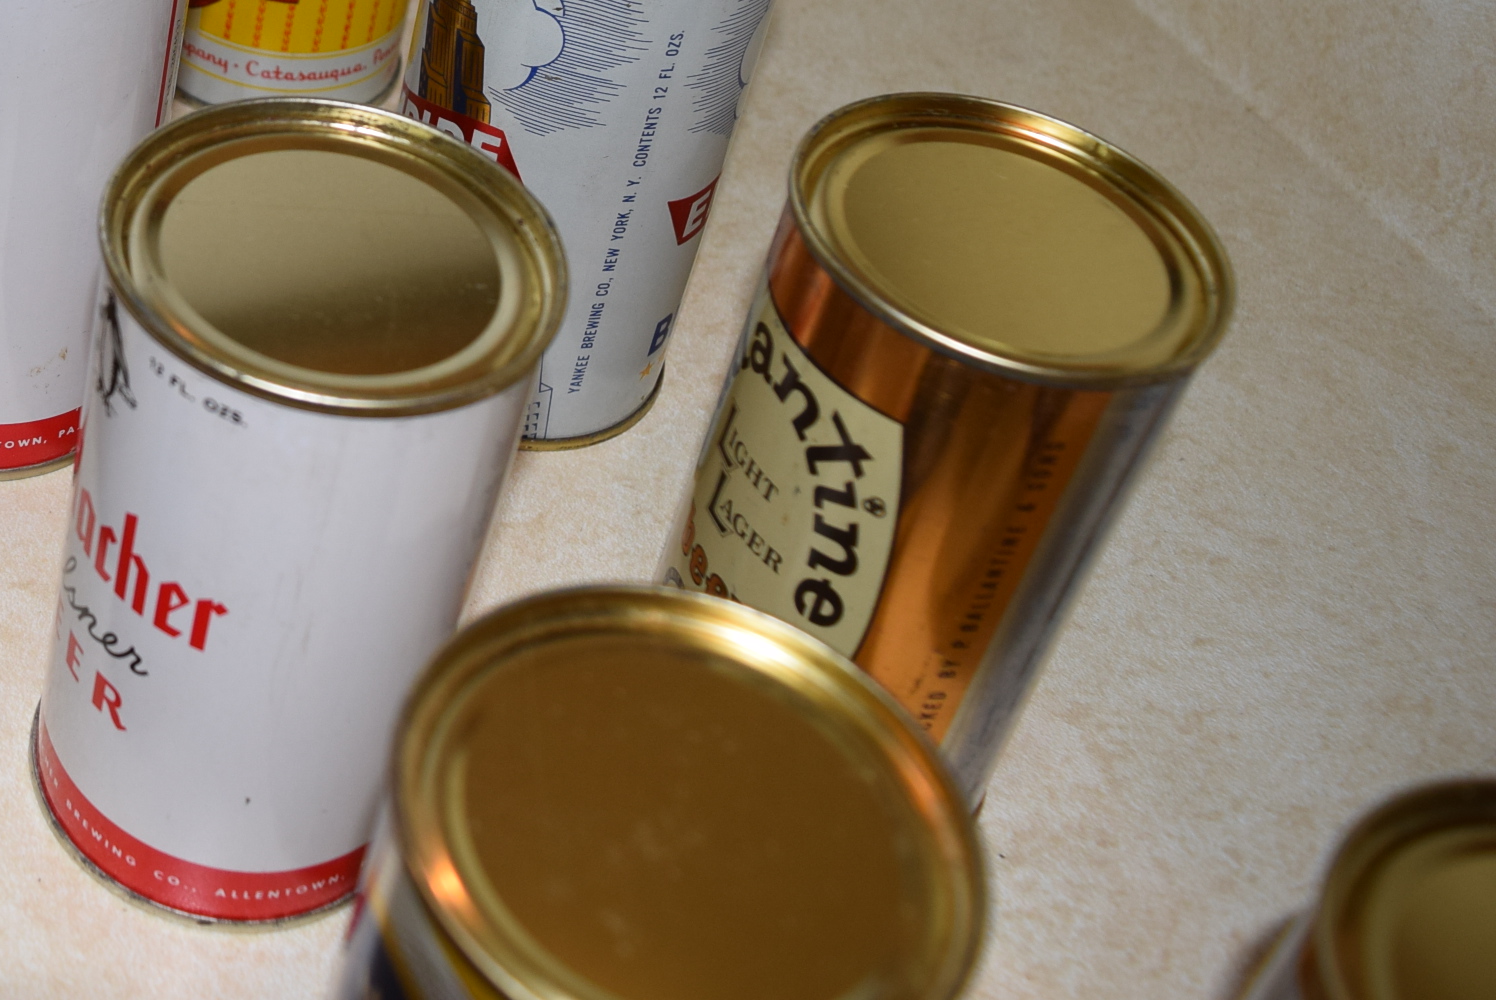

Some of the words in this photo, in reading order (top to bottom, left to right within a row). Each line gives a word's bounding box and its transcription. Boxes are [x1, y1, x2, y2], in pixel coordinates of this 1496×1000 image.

[665, 29, 685, 57] OZS.
[658, 62, 676, 80] FL.
[652, 86, 669, 100] 12
[632, 106, 663, 168] CONTENTS
[622, 191, 638, 203] N.
[627, 176, 642, 188] Y.
[611, 208, 635, 242] YORK,
[602, 248, 621, 272] NEW
[596, 277, 615, 297] CO.,
[581, 302, 605, 350] BREWING
[149, 356, 165, 378] 12
[203, 397, 248, 428] OZS.
[567, 353, 591, 395] YANKEE
[717, 403, 781, 503] LIGHT
[708, 470, 785, 575] LAGER
[70, 476, 230, 653] acher
[65, 798, 137, 868] BREWING
